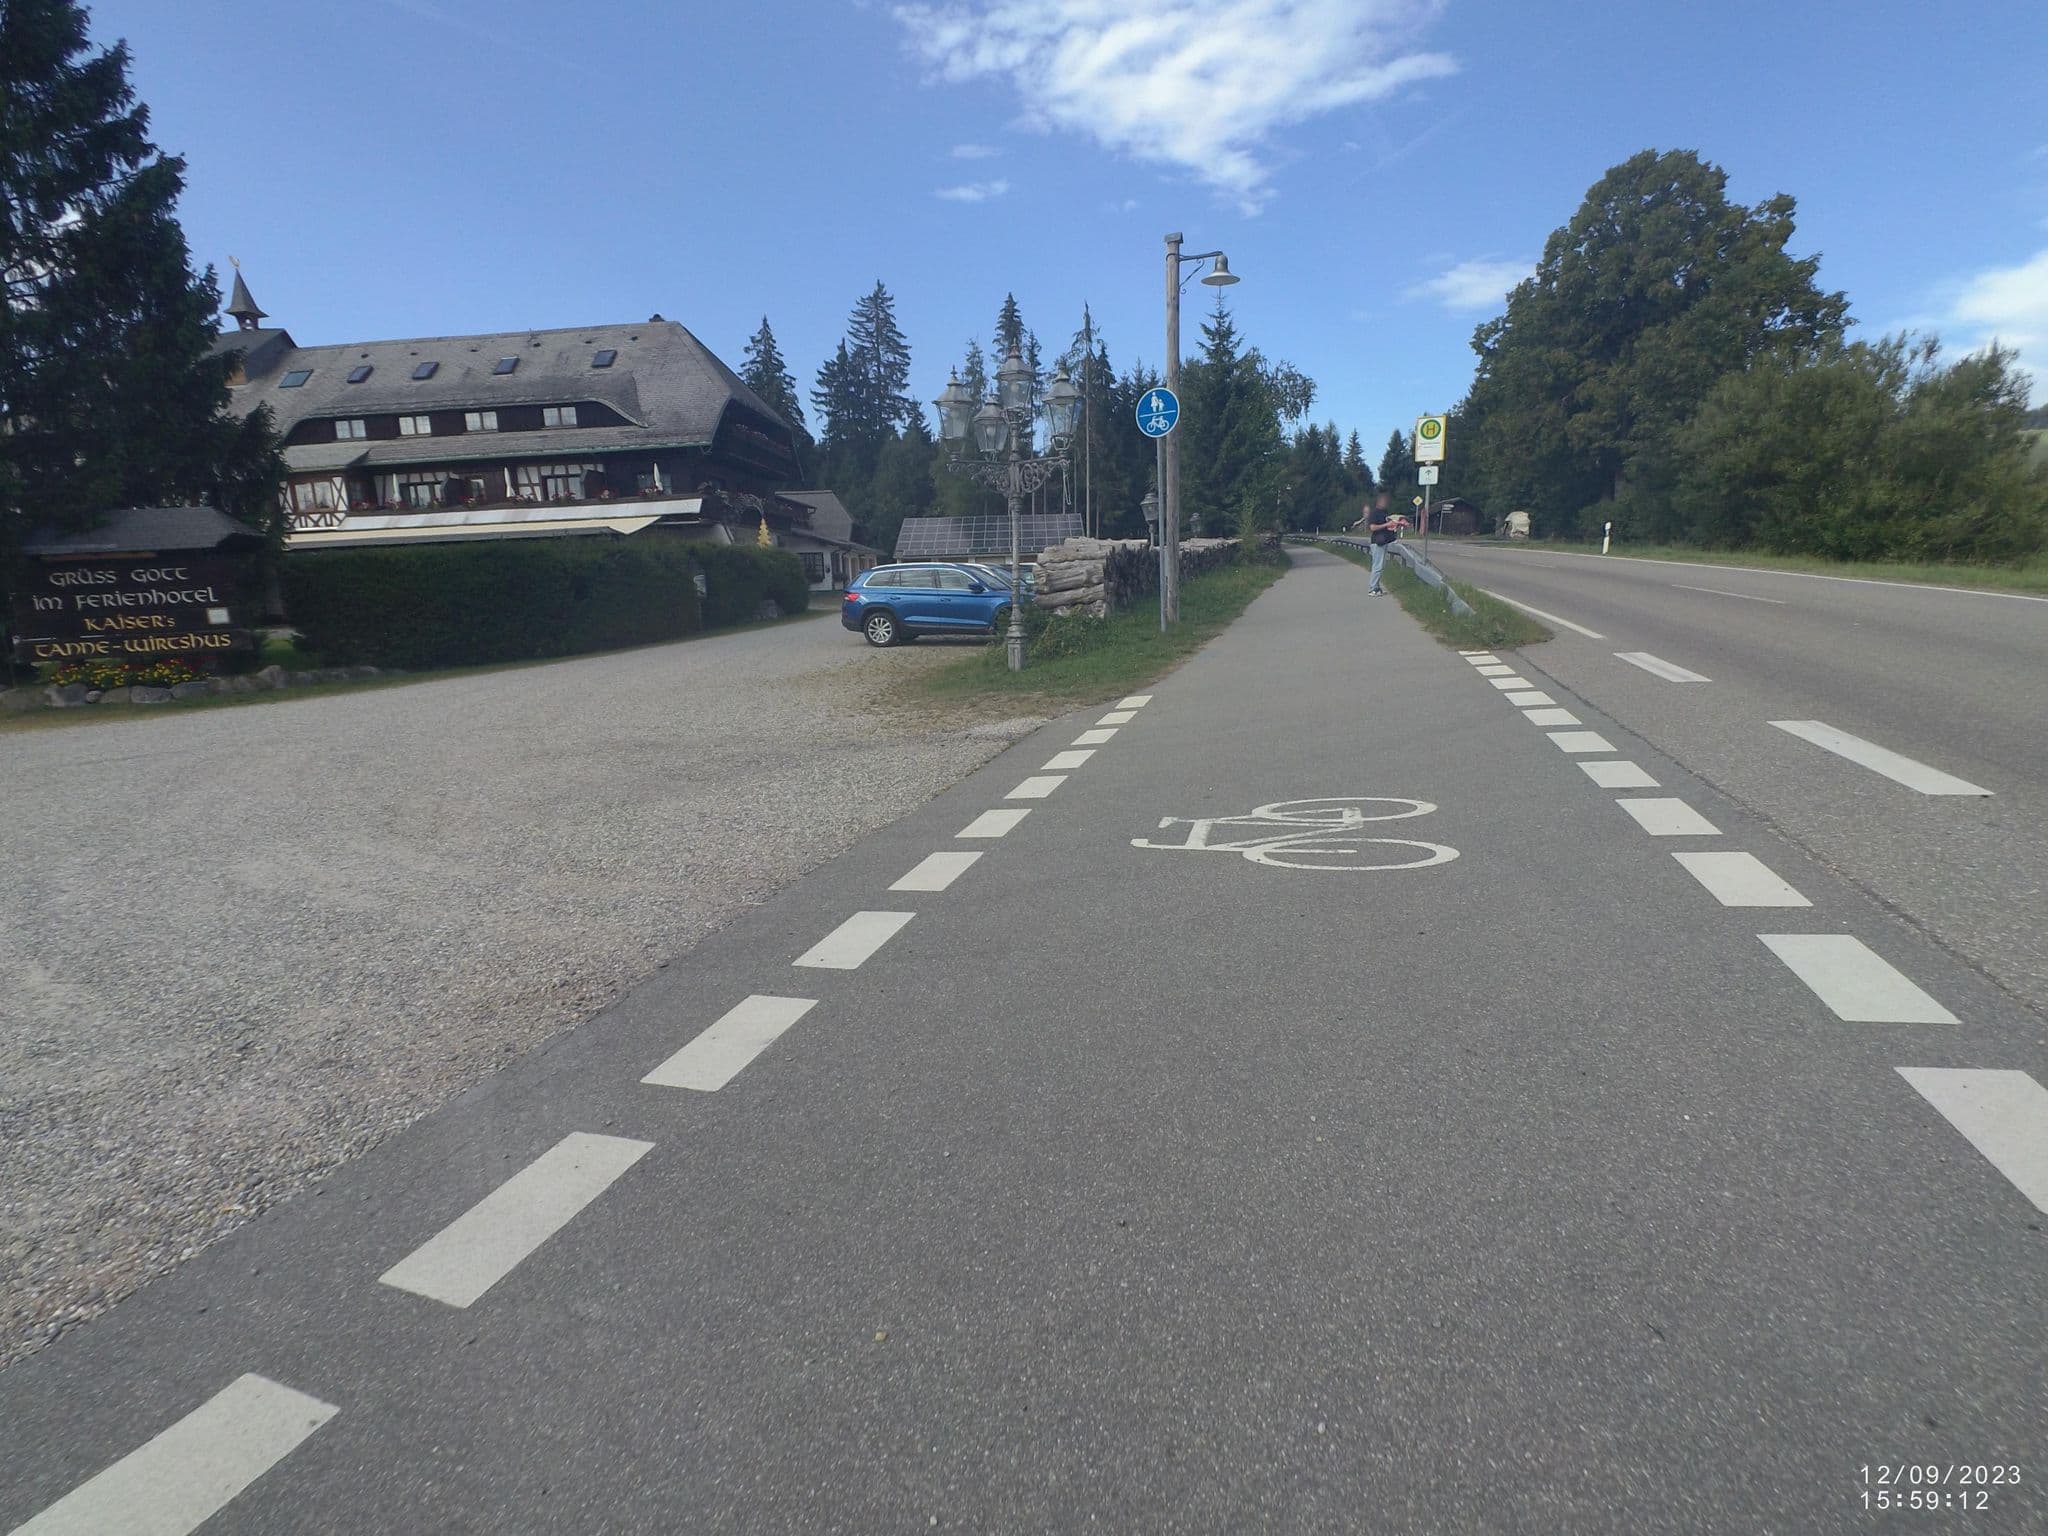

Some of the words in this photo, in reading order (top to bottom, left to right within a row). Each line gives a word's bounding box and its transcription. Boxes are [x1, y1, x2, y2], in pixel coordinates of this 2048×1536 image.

[1426, 423, 1436, 436] H
[49, 568, 117, 587] GRÜSS
[130, 567, 190, 584] GOTT
[75, 586, 219, 611] FERIENHOTEL
